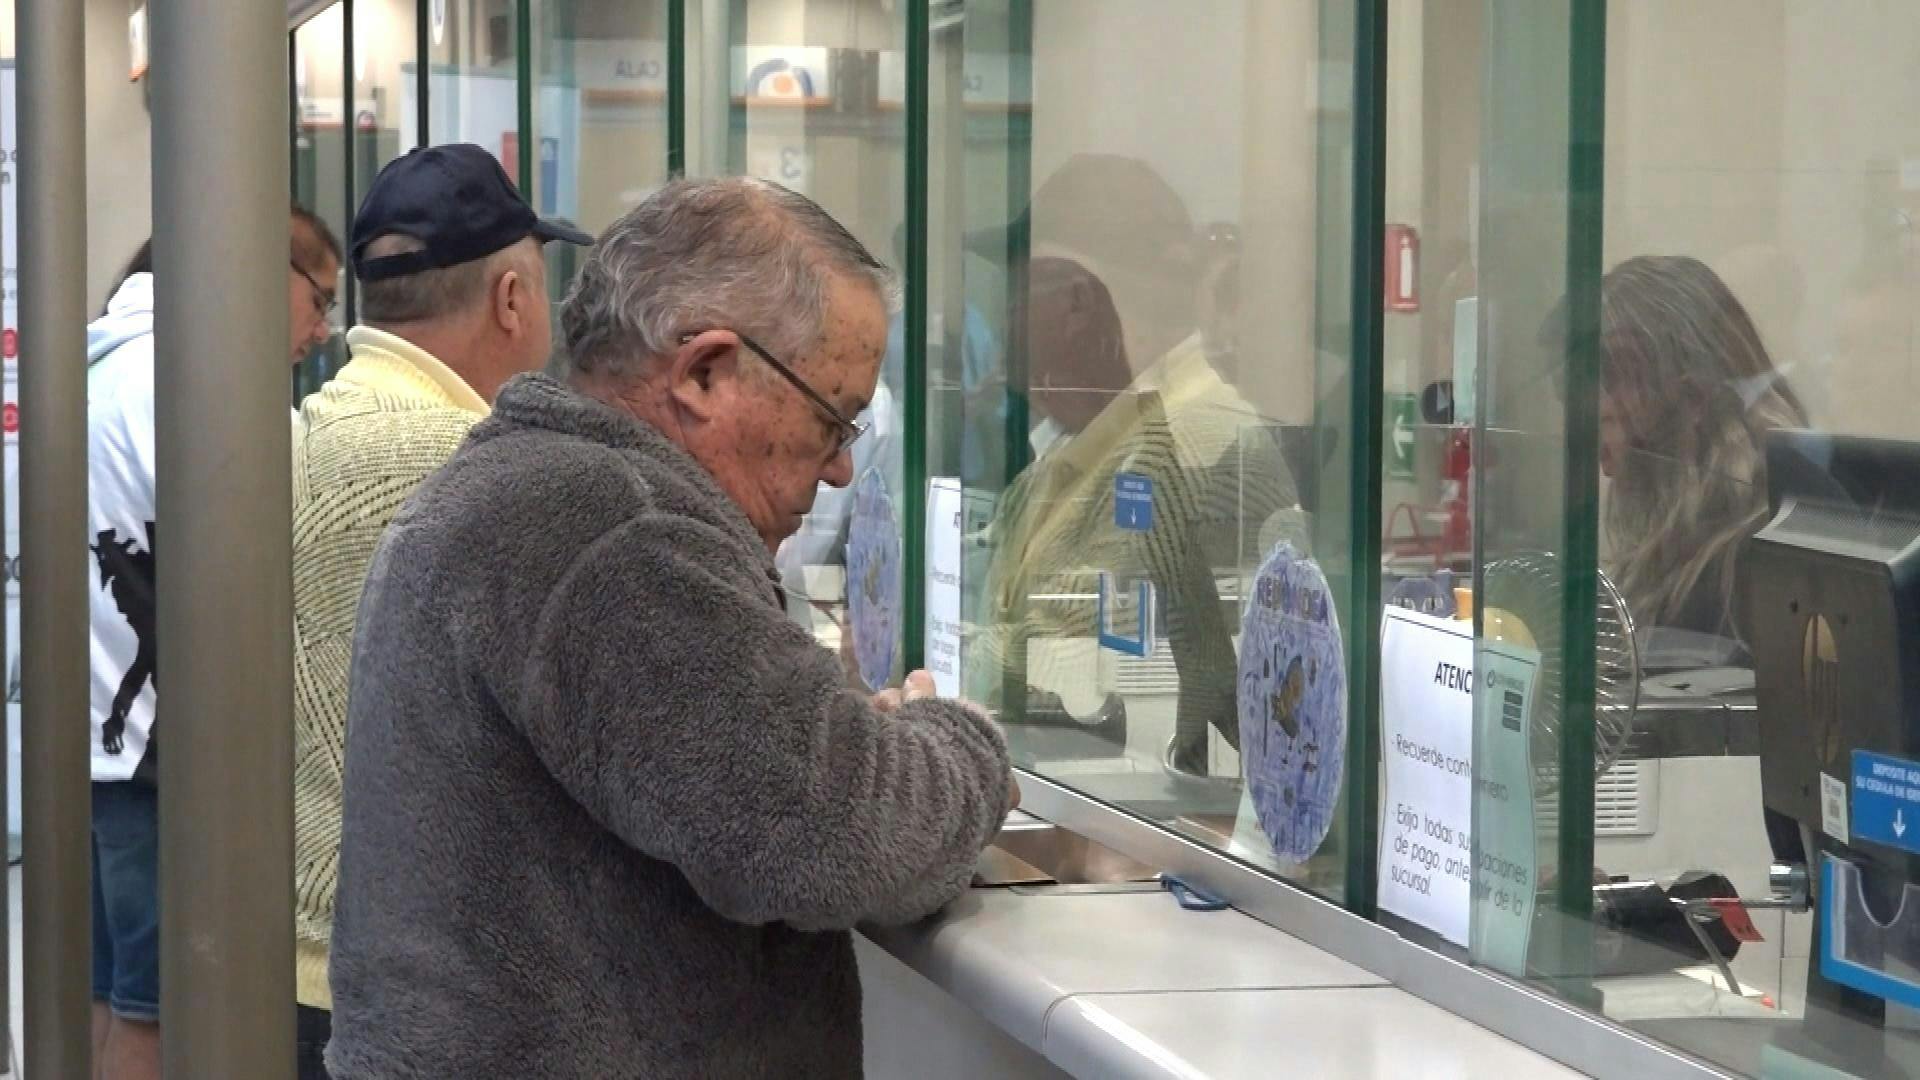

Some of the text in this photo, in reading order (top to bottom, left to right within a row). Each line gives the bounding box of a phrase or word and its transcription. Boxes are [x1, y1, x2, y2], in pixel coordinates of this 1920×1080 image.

[1433, 661, 1473, 694] ATENC
[1396, 733, 1444, 769] Recuerde
[1394, 832, 1408, 855] de
[1424, 811, 1453, 844] todas
